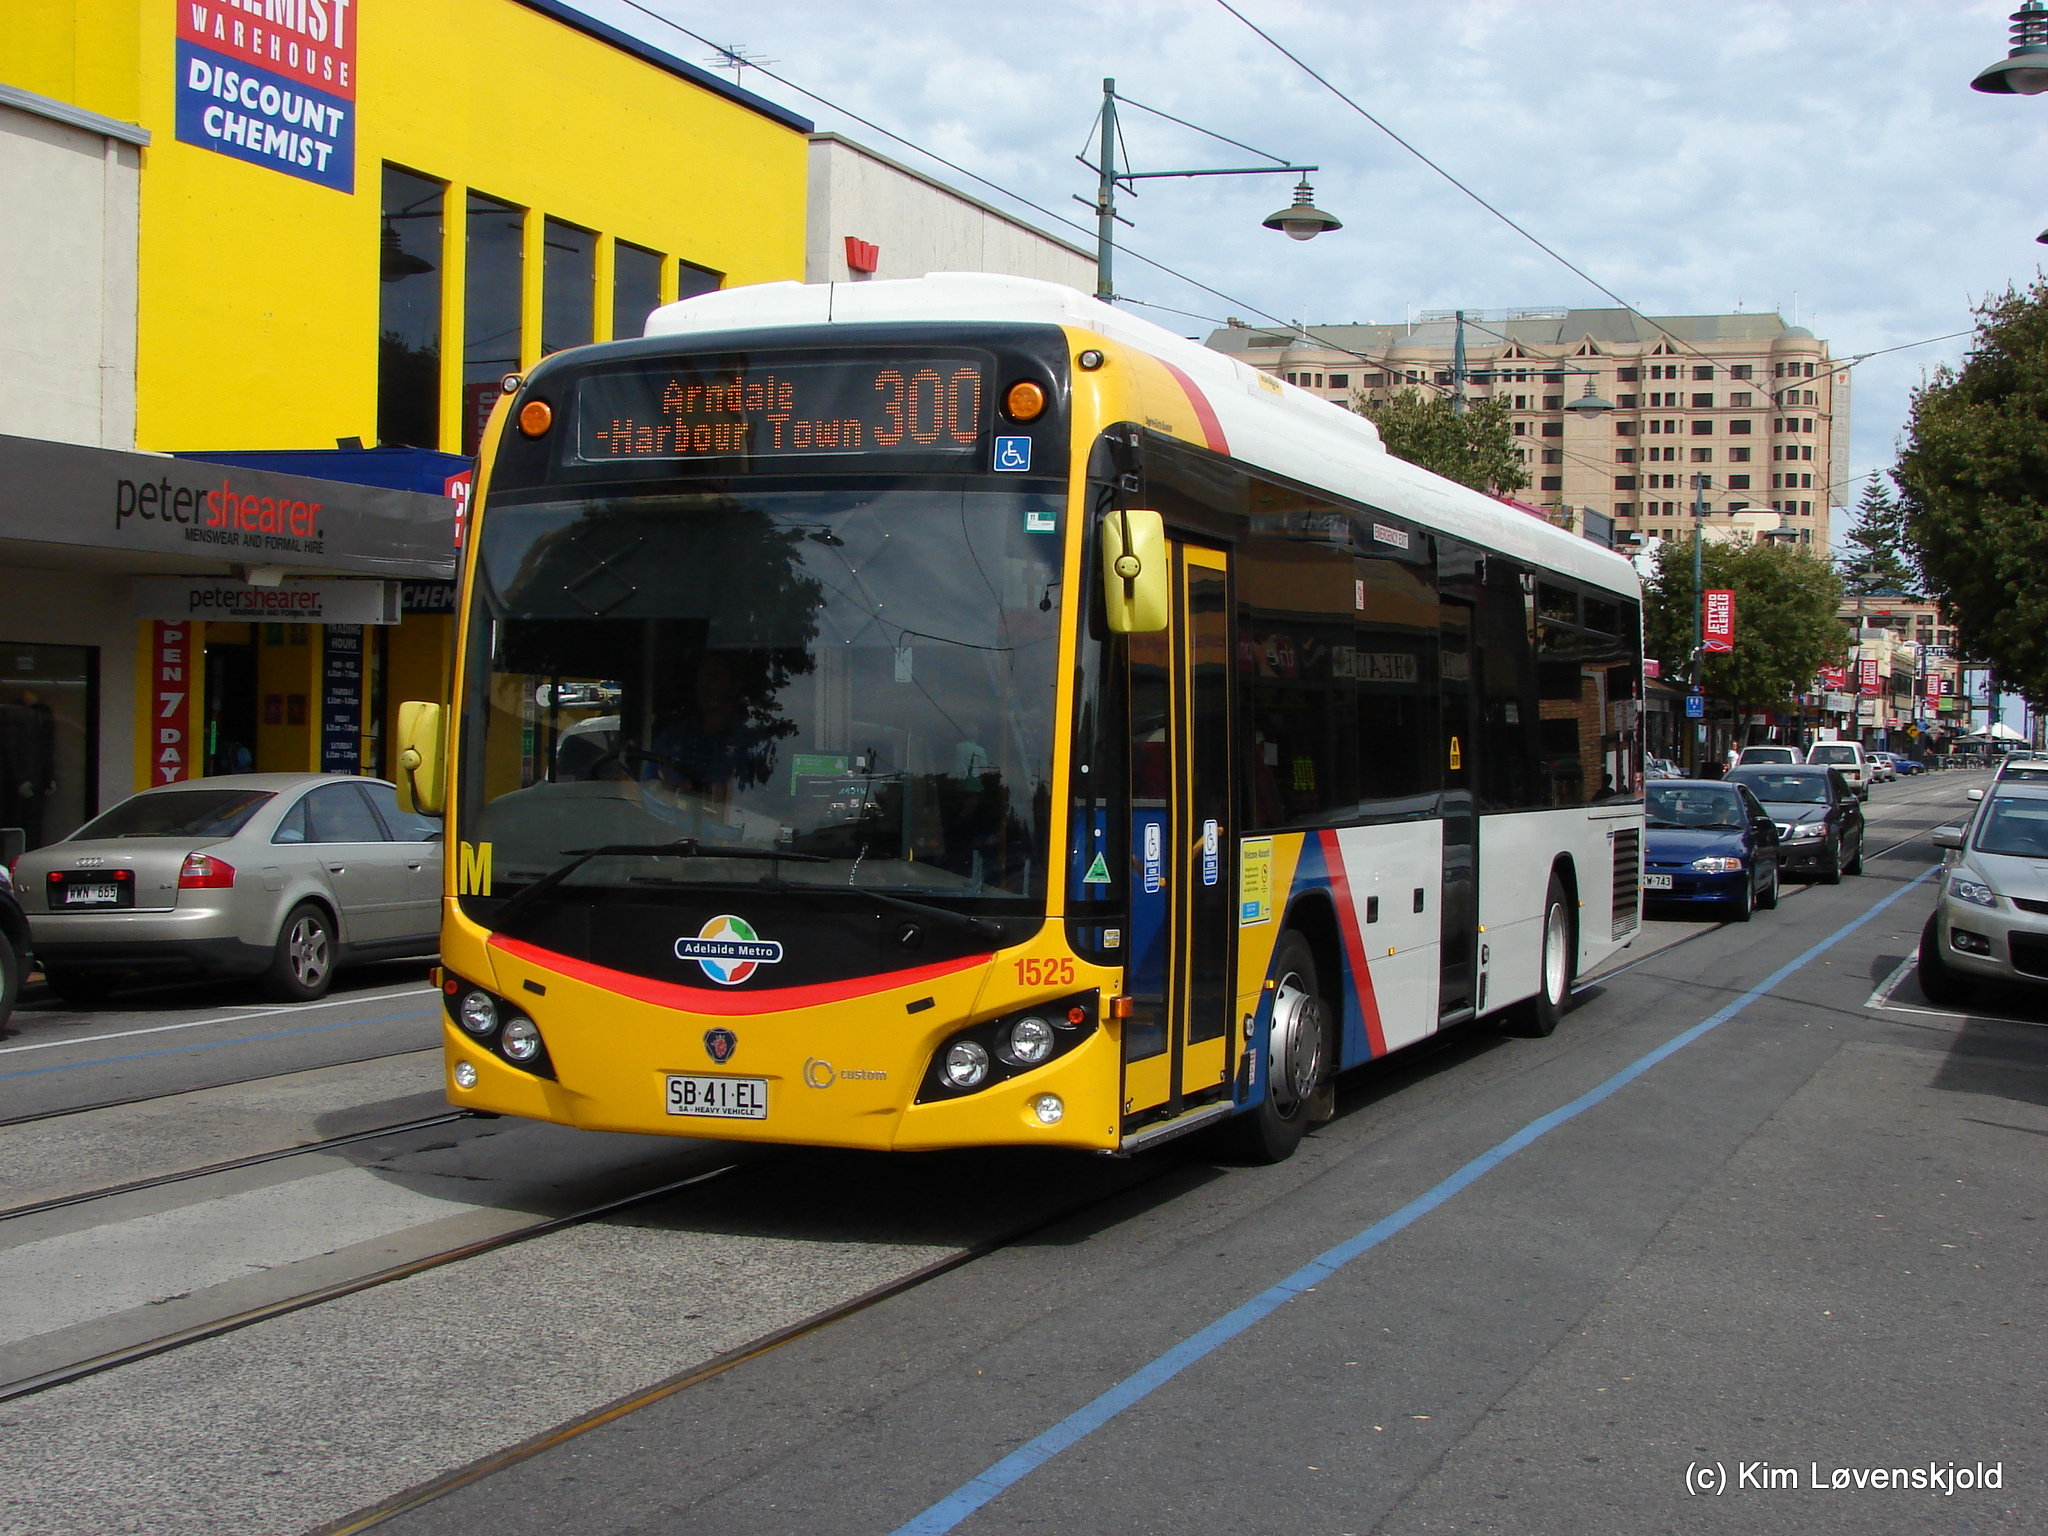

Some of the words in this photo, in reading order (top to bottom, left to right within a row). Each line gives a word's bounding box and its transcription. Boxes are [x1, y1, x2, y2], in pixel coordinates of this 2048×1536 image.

[191, 3, 349, 87] WAREHOUSE
[188, 57, 345, 138] DISCOUNT
[203, 105, 334, 173] CHEMIST
[662, 374, 794, 414] Arndale
[873, 366, 981, 446] 300
[766, 412, 862, 450] Town
[184, 527, 240, 546] MENSWEAR
[242, 532, 262, 548] AND
[264, 535, 302, 552] FORMAL
[304, 540, 325, 554] HIRE
[331, 637, 357, 650] HOURS
[160, 692, 185, 718] 7
[460, 841, 493, 897] M
[685, 943, 735, 955] Adelaide
[738, 945, 773, 957] Metro
[1013, 957, 1075, 986] 1525
[840, 1068, 887, 1081] custom
[694, 1106, 721, 1114] HEAVY
[721, 1107, 756, 1116] VEHICLE
